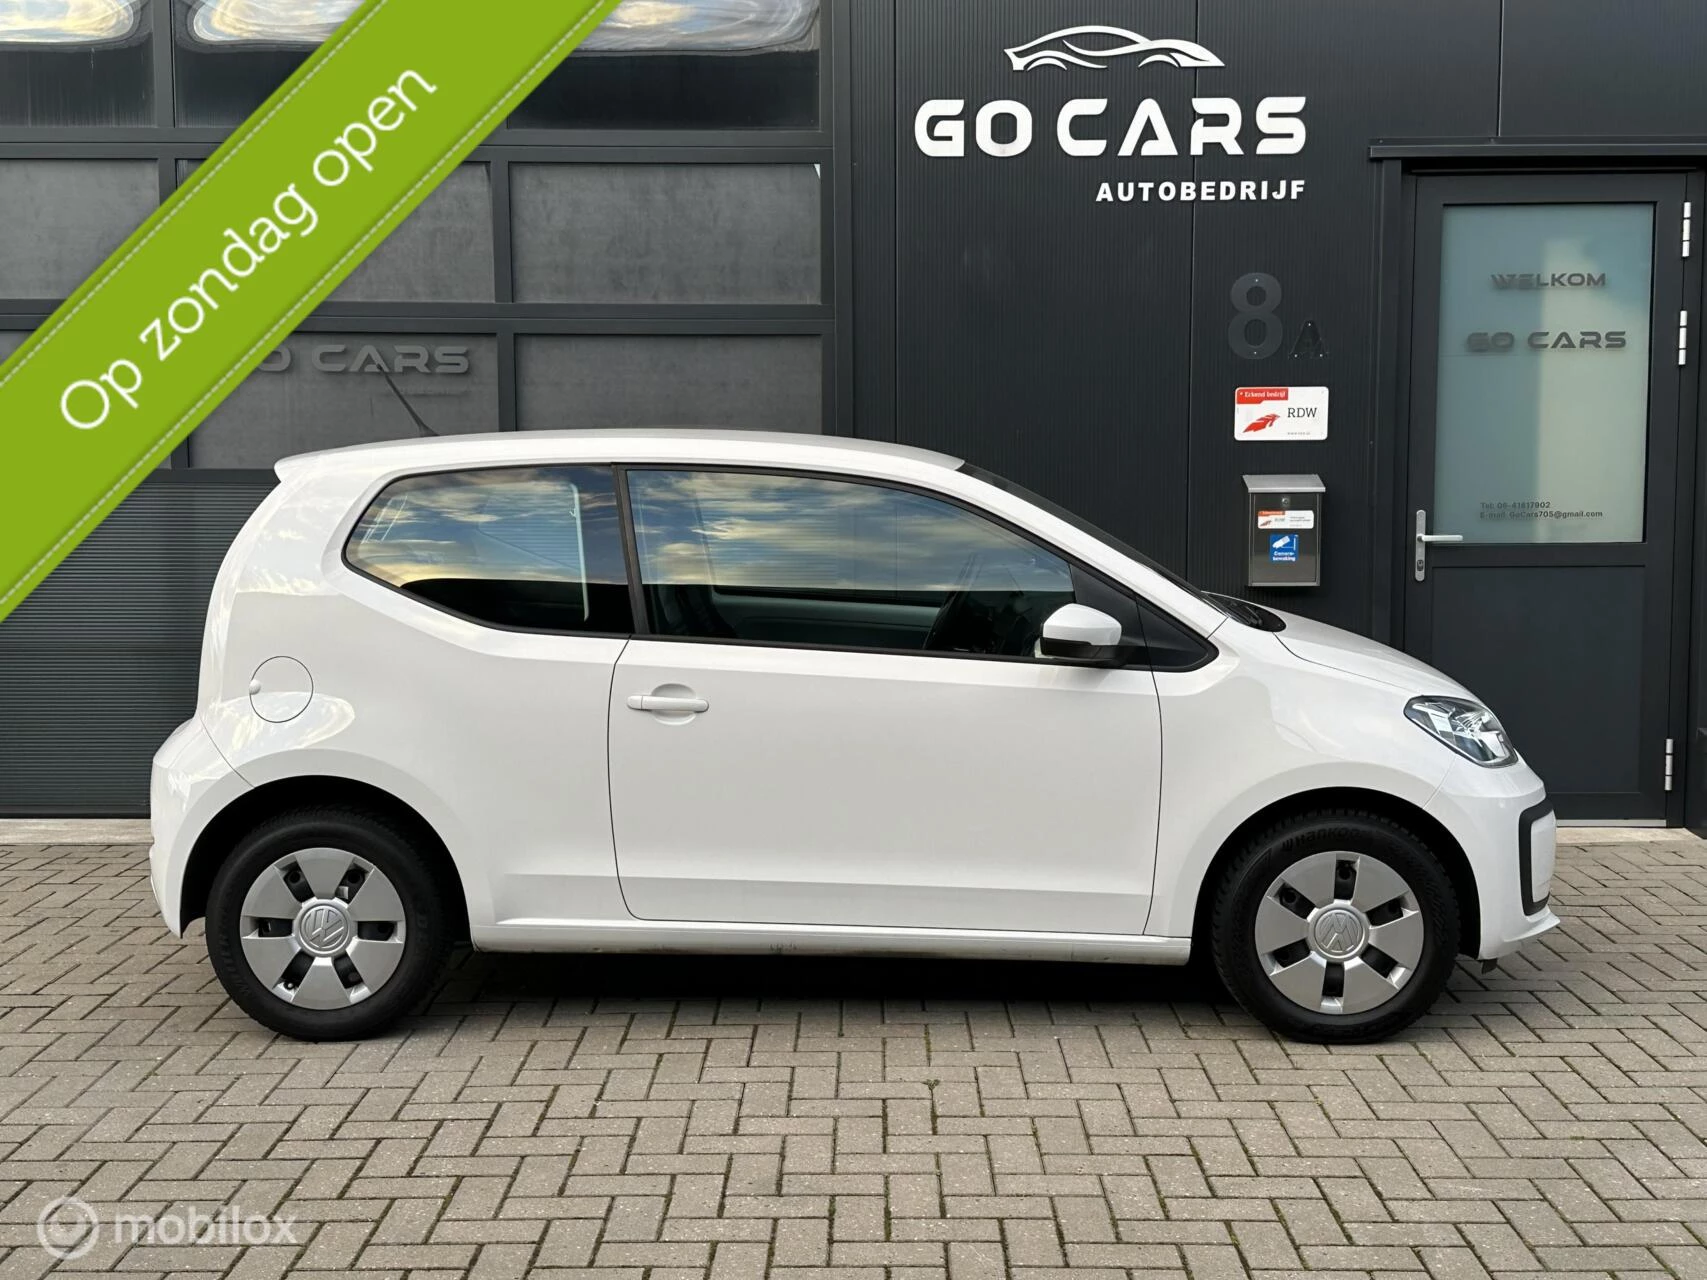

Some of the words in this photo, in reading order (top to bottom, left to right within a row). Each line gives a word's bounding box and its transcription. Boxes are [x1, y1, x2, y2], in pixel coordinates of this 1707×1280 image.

[914, 99, 1033, 157] GO
[1056, 96, 1306, 156] CARS
[1096, 180, 1305, 202] AUTOBEDRIJF
[1491, 273, 1606, 289] WELKOM
[1466, 332, 1515, 350] GO
[1527, 331, 1627, 349] CARS
[312, 344, 470, 374] CARS
[1287, 407, 1318, 418] RDW
